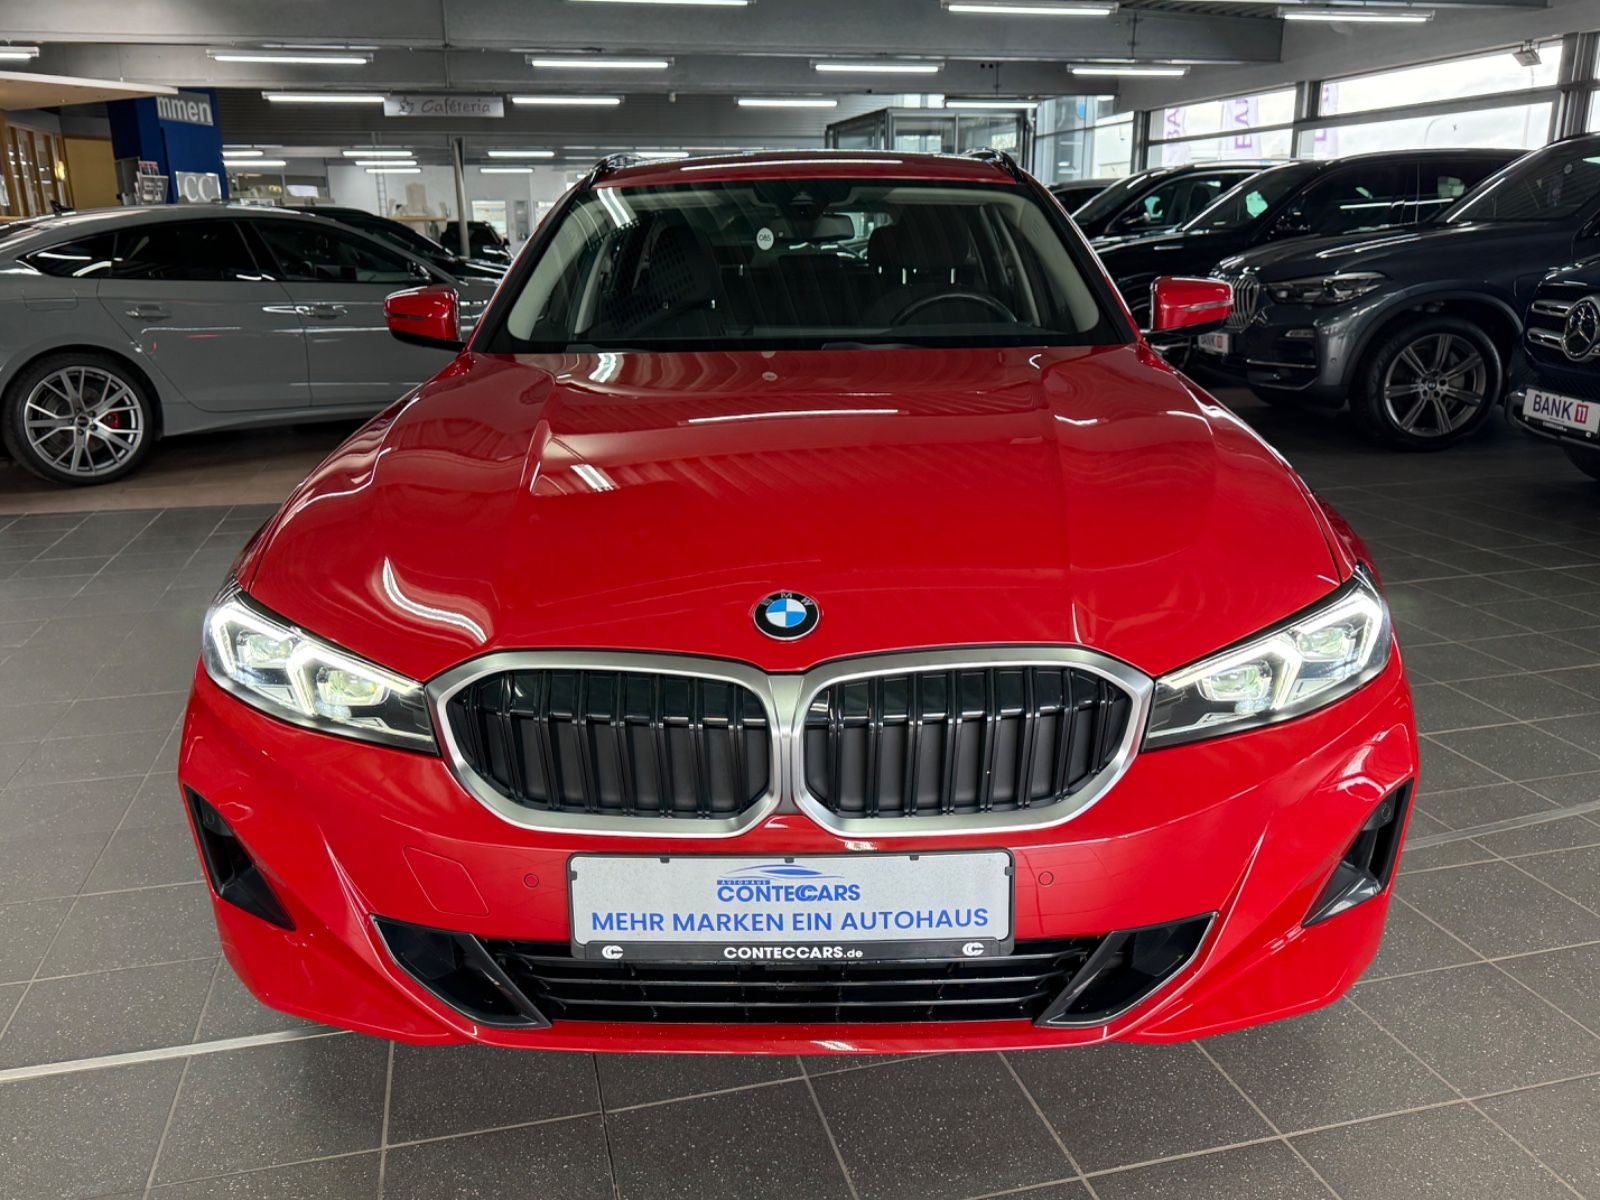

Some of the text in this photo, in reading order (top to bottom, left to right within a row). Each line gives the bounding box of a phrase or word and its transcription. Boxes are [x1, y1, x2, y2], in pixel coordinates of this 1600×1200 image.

[1533, 394, 1573, 421] BANK
[717, 884, 861, 902] CONTECCARS
[592, 908, 989, 932] MEHR MARKEN EIN AUTOHAUS
[723, 946, 864, 960] CONTECCARS.de
